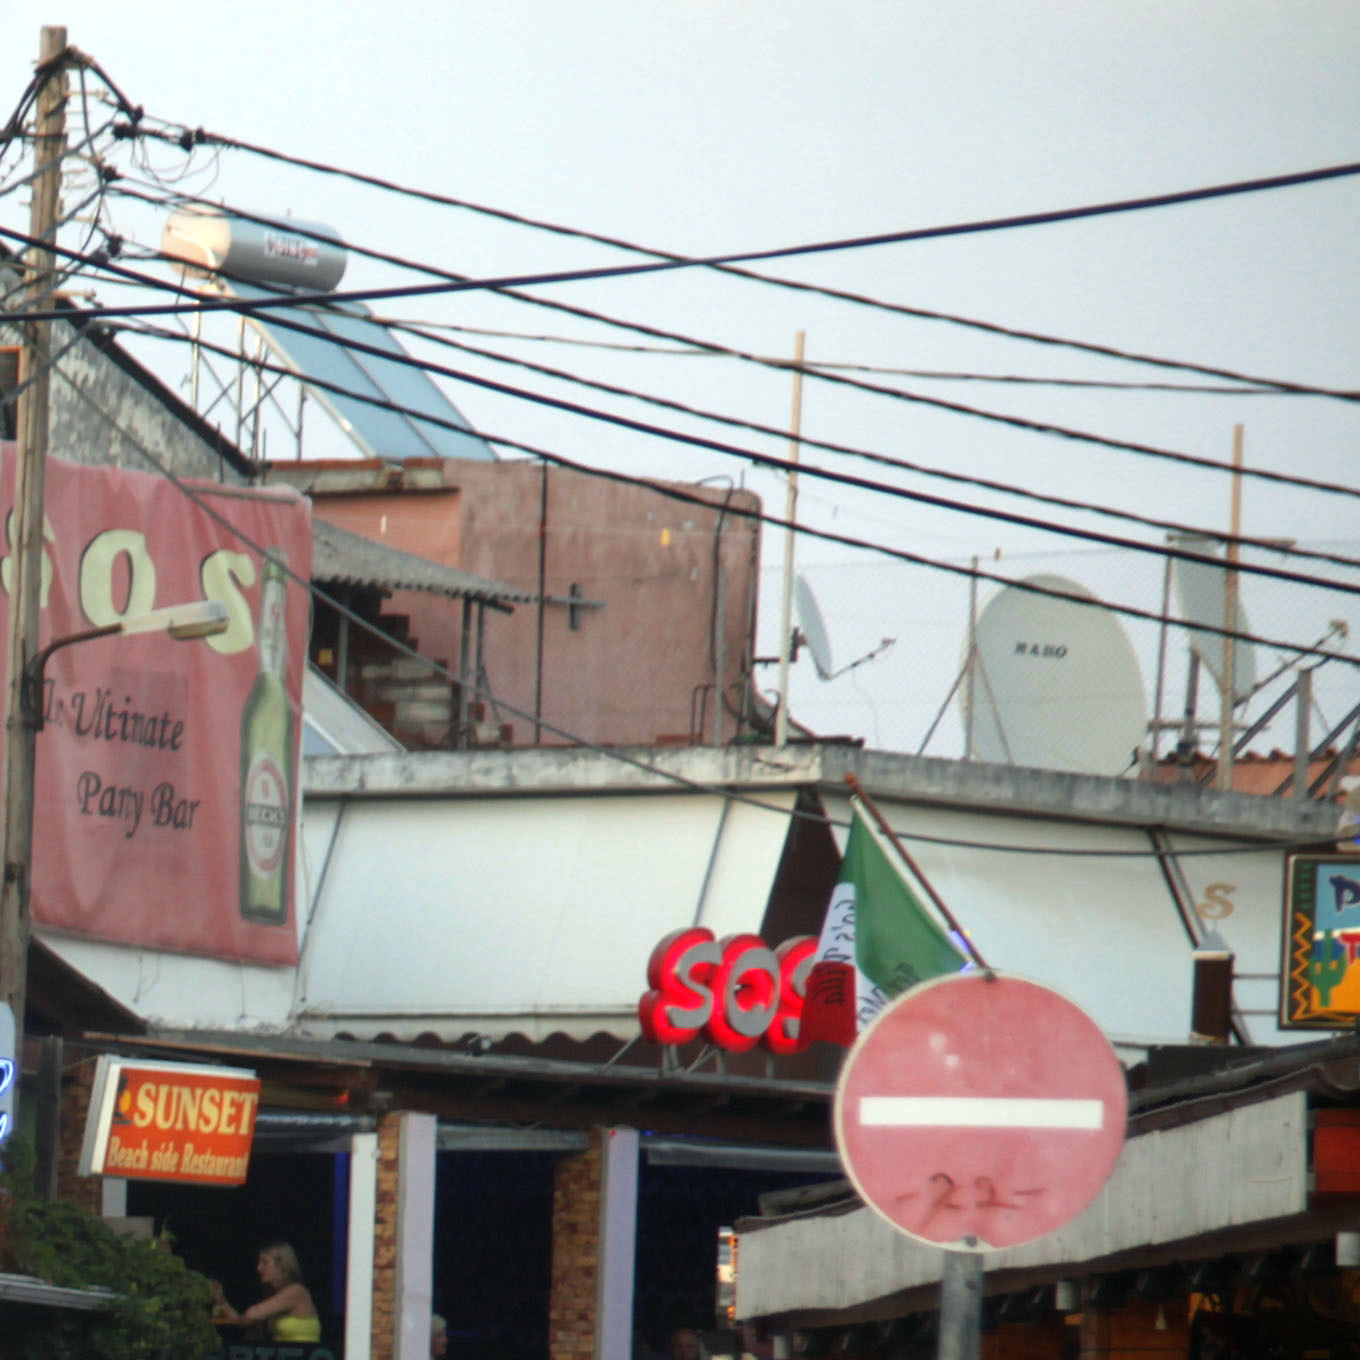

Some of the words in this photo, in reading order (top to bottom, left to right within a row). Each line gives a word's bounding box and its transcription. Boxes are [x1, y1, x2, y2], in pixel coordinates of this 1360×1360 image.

[152, 781, 201, 832] Bar
[133, 1082, 260, 1135] SUNSET
[107, 1136, 149, 1170] Beach
[151, 1141, 180, 1174] side
[181, 1142, 249, 1179] Restaurant
